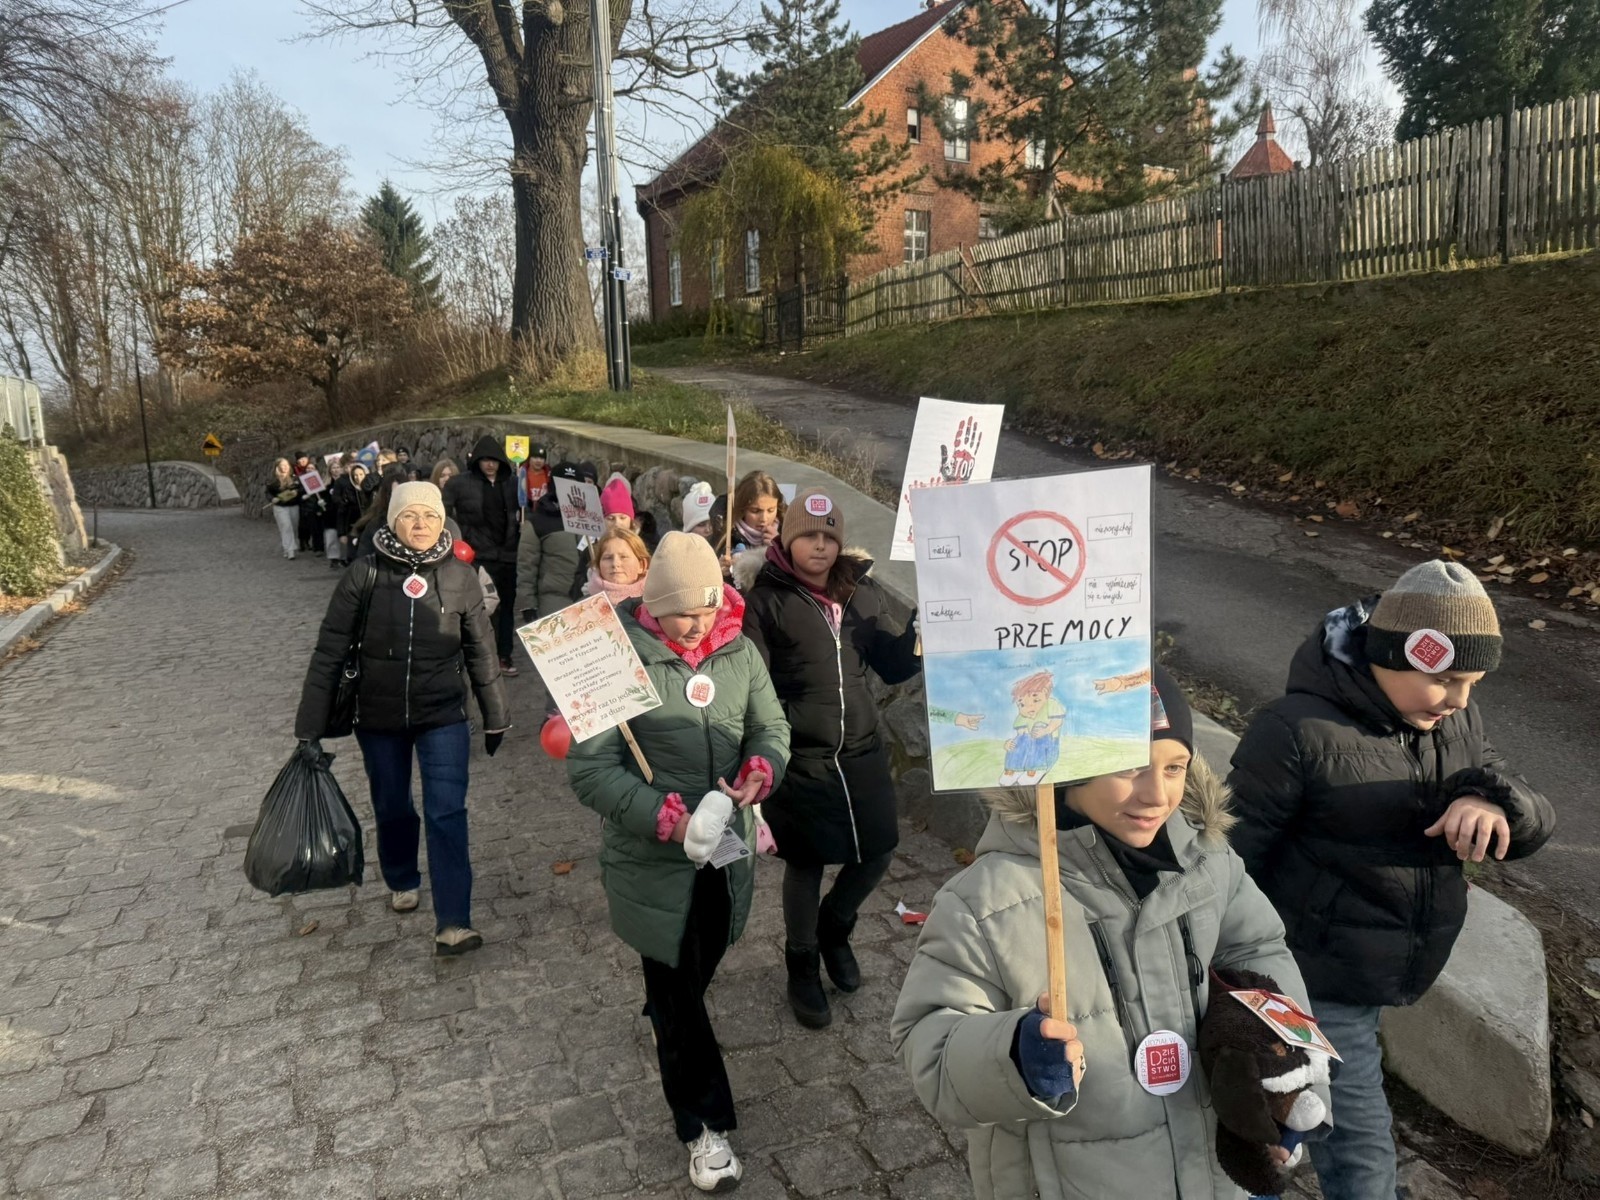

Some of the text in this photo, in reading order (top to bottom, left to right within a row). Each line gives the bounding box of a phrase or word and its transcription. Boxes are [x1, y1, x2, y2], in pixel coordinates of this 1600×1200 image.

[944, 457, 975, 478] STOP
[1008, 538, 1073, 572] STOP
[995, 616, 1132, 650] PRZEMOCY
[548, 652, 568, 664] Przemoc
[580, 641, 591, 649] musi
[593, 635, 603, 643] być
[559, 656, 574, 666] tylko
[573, 670, 606, 688] krytykowanie
[573, 680, 598, 694] przykłady
[600, 670, 622, 682] przemocy
[567, 706, 597, 725] pierwszy
[598, 702, 609, 710] raz
[1151, 1064, 1176, 1074] STWO
